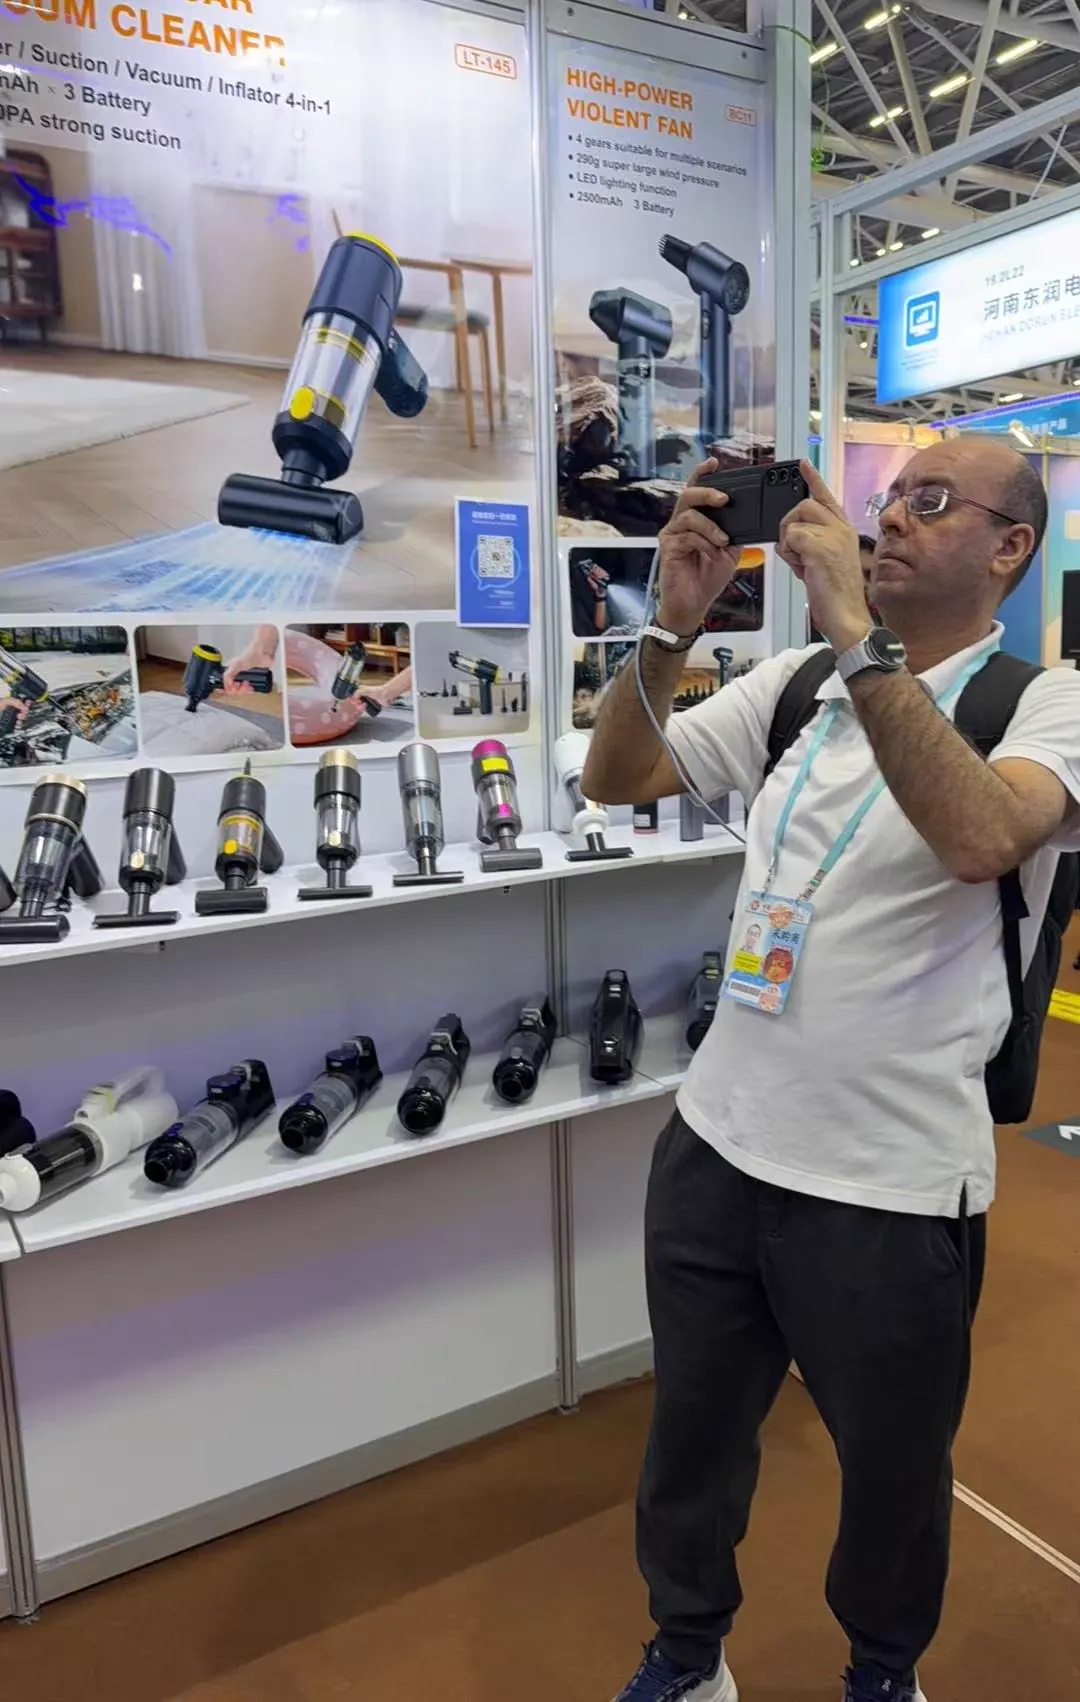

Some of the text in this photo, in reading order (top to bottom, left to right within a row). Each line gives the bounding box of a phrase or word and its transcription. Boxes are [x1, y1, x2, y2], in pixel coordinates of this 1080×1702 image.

[463, 48, 511, 74] LT-145
[31, 43, 109, 75] Suction
[125, 61, 201, 91] Vacuum
[219, 77, 281, 105] Inflator
[285, 92, 331, 115] 4-in-1
[567, 66, 693, 111] HIGH-POWER
[64, 83, 75, 101] 3
[81, 85, 151, 117] Battery
[40, 113, 105, 141] strong
[111, 126, 181, 150] suction
[567, 98, 693, 140] VIOLENT FAN
[575, 133, 747, 176] 4 gears suitable for multiple scenarios
[577, 172, 677, 198] LED lighting function
[602, 159, 630, 171] super
[632, 162, 657, 176] large
[659, 168, 681, 180] wind
[682, 173, 720, 188] pressure
[577, 191, 674, 218] 2500mAh 3 Battery
